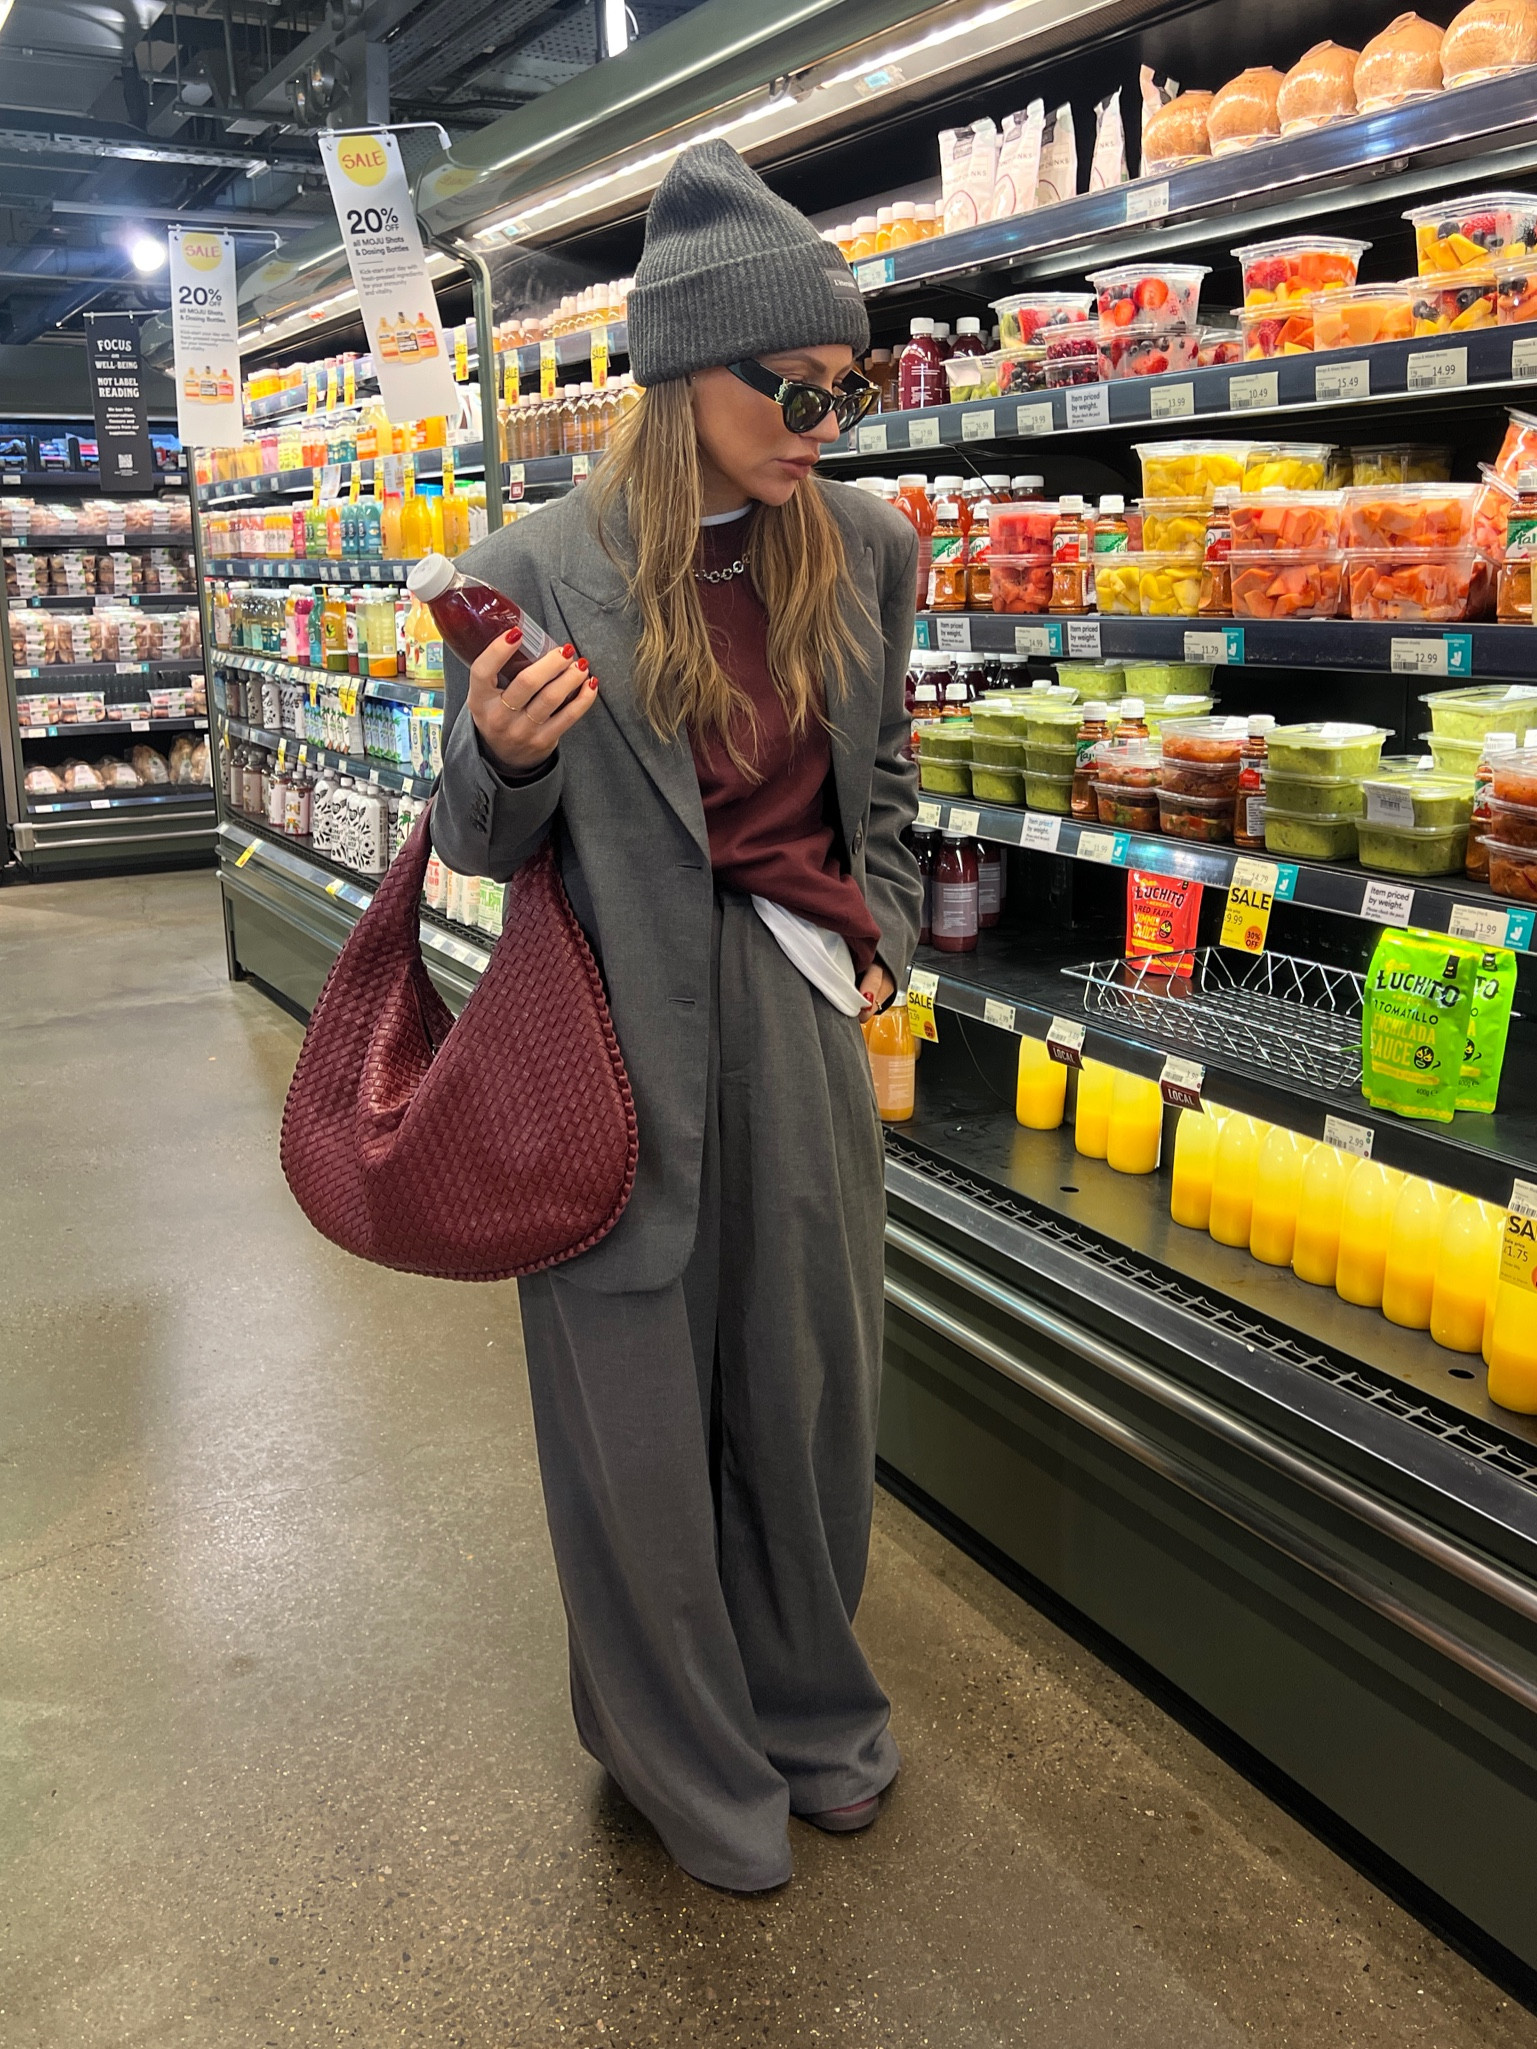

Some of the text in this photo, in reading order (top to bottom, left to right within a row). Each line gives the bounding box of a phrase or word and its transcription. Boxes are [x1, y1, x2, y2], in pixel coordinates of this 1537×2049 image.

[342, 150, 385, 170] SALE
[347, 208, 399, 234] 20% OFF
[353, 239, 361, 247] all
[362, 238, 384, 246] MOJU
[185, 245, 221, 258] SALE
[179, 286, 222, 306] 20%
[97, 339, 132, 352] FOCUS
[95, 361, 138, 370] WELL-BEING
[1432, 365, 1455, 377] 14.99
[97, 377, 138, 386] NOT LABEL
[1338, 377, 1358, 388] 15.49
[99, 387, 140, 398] READING
[1084, 393, 1100, 401] priced
[1249, 388, 1268, 399] 10.49
[1168, 397, 1185, 409] 13.99
[1415, 653, 1437, 664] 12.99
[1231, 888, 1272, 911] SALE
[1370, 887, 1410, 901] Item priced
[1368, 896, 1403, 910] by weight.
[1138, 905, 1174, 918] RED FAJITA
[1133, 923, 1158, 941] SAUCE
[1475, 922, 1497, 935] 11.99
[1246, 931, 1260, 948] 30% OFF
[908, 991, 932, 1010] SALE
[1379, 1002, 1439, 1025] TOMATILLO
[1373, 1013, 1436, 1044] ENCHILADA
[1053, 1047, 1076, 1063] LOCAL
[1371, 1034, 1414, 1066] SAUCE
[1168, 1088, 1195, 1105] LOCAL
[1416, 1088, 1430, 1097] 400g
[1349, 1136, 1364, 1148] 2.99
[1509, 1215, 1537, 1241] SA
